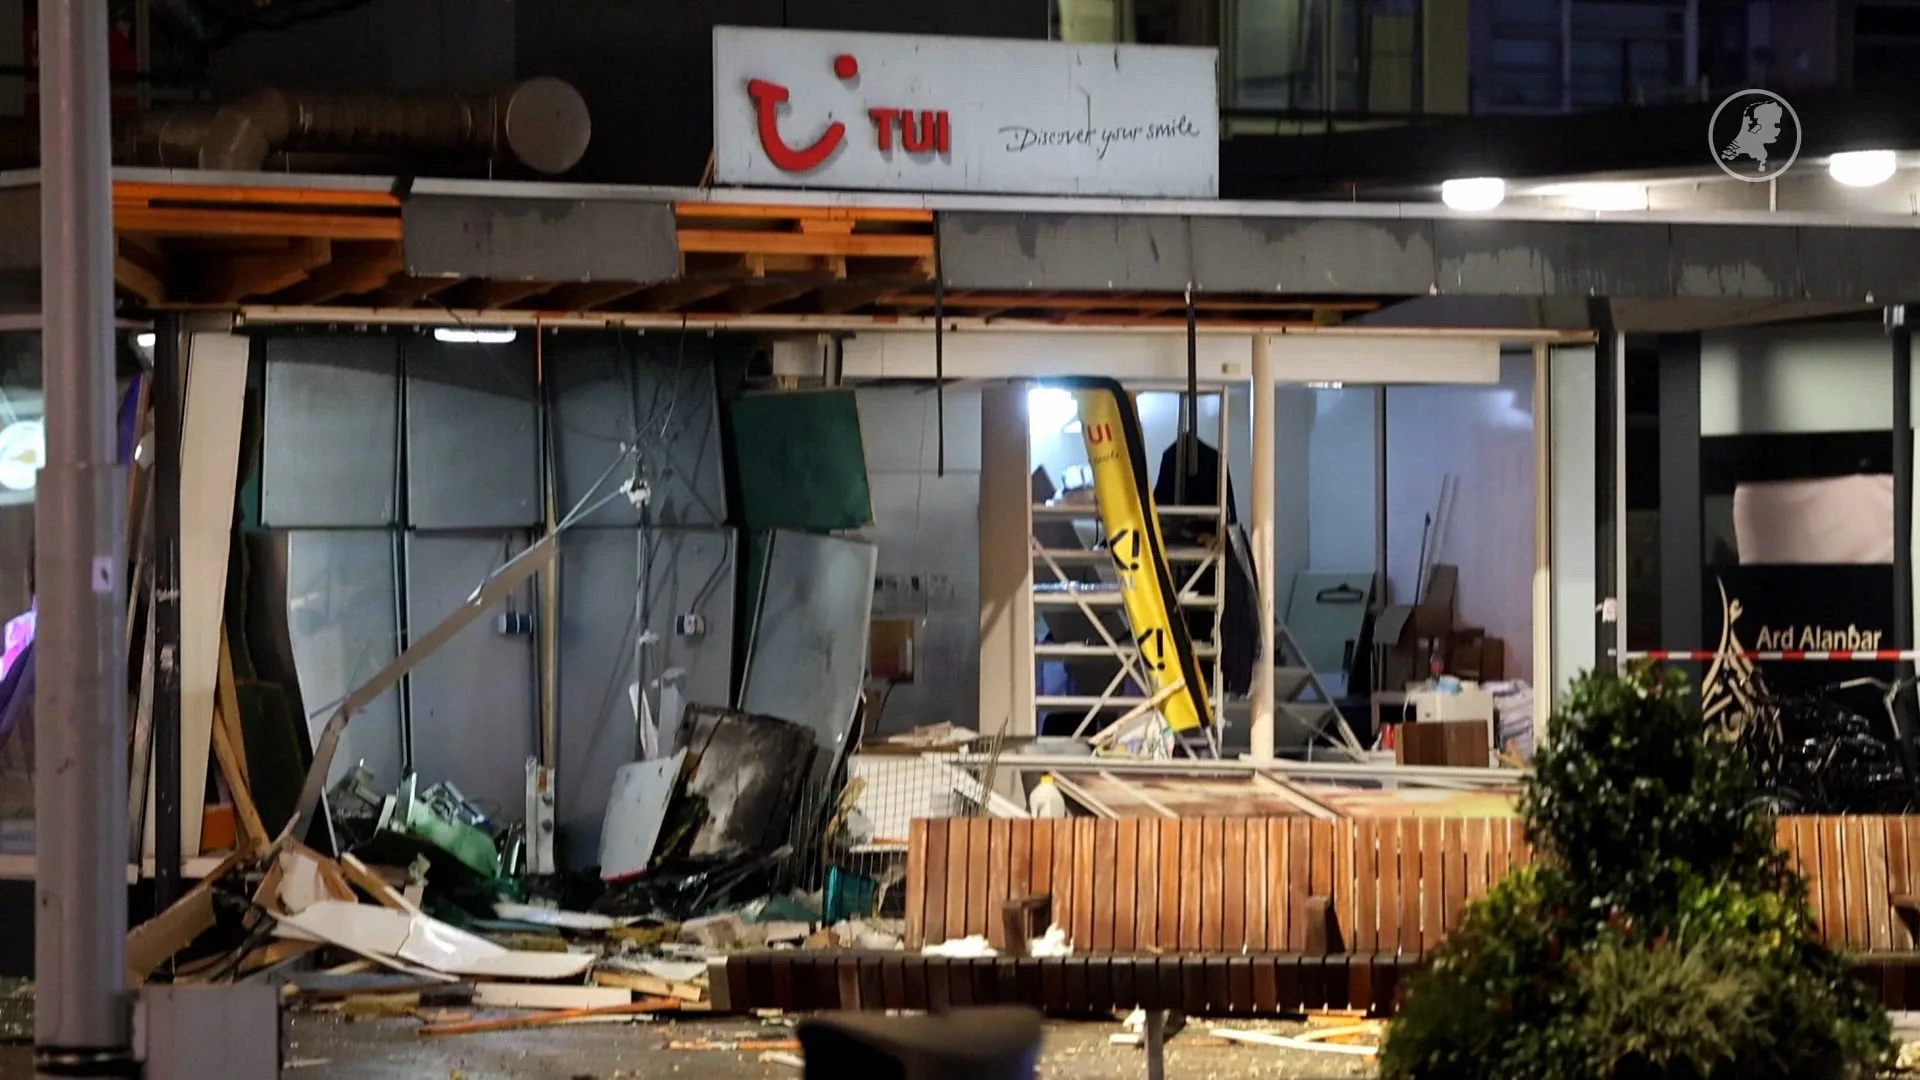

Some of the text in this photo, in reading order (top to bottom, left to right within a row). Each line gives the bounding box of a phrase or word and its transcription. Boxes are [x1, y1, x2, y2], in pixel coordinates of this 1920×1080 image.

[868, 106, 950, 153] TUI
[998, 114, 1200, 160] Discover your smile
[1756, 623, 1882, 651] Ard Alanbar
